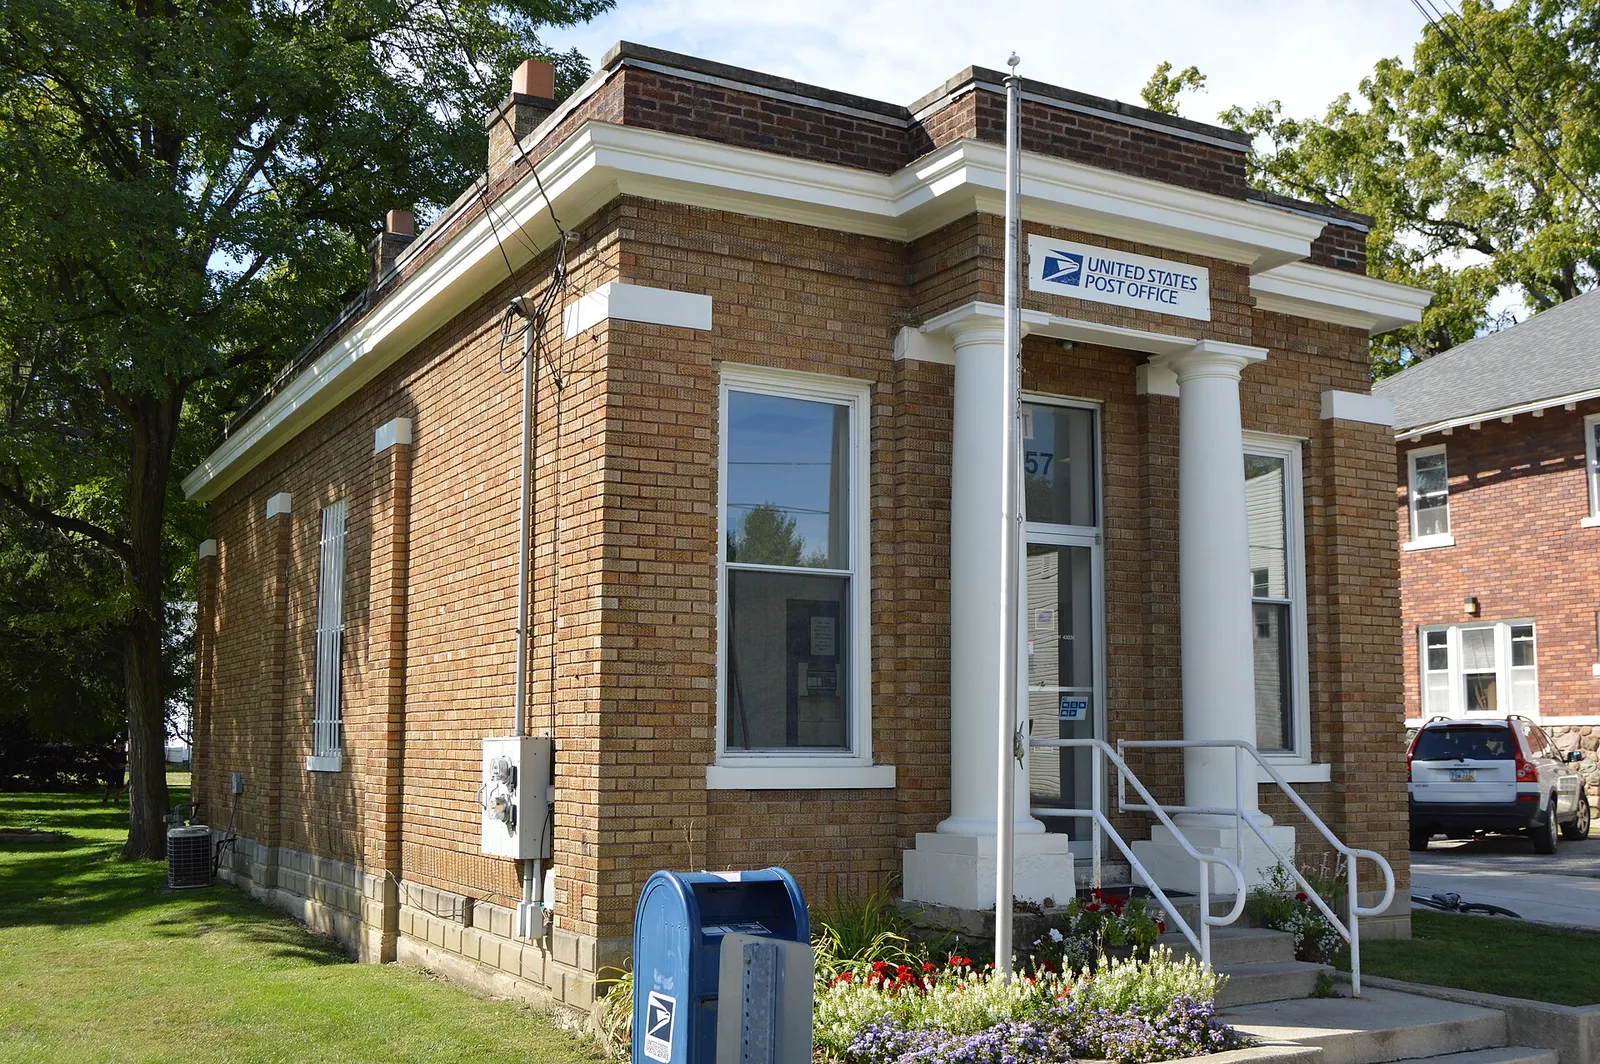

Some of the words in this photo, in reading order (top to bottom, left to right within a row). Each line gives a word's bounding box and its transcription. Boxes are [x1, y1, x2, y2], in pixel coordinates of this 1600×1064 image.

[1085, 274, 1126, 294] POST
[1127, 283, 1178, 304] OFFICE
[1088, 257, 1145, 280] UNITED
[1147, 268, 1198, 291] STATES
[1024, 451, 1054, 475] 57
